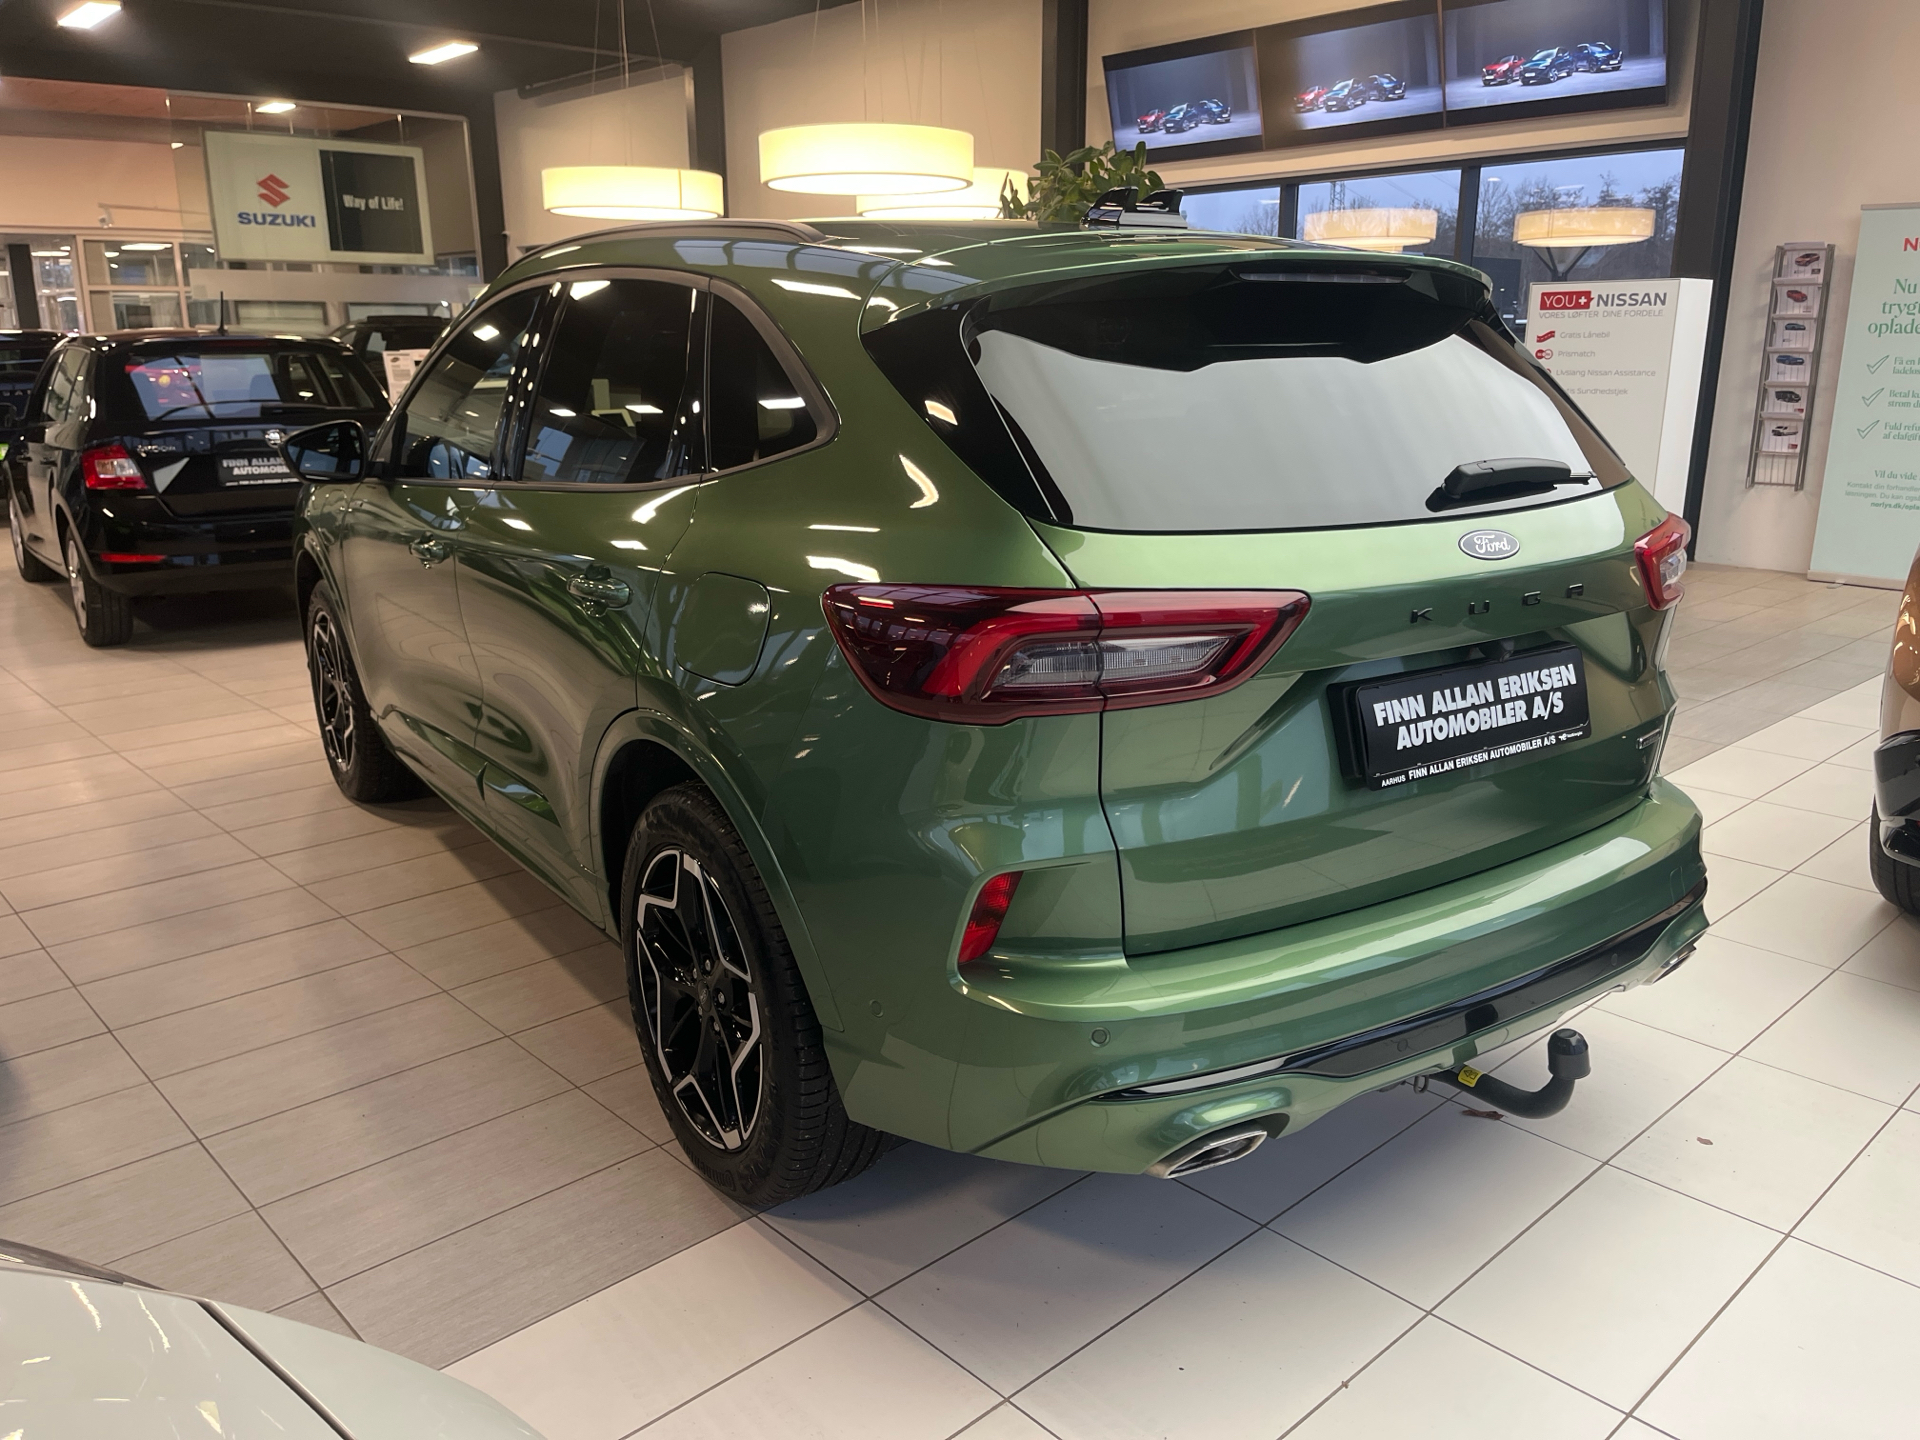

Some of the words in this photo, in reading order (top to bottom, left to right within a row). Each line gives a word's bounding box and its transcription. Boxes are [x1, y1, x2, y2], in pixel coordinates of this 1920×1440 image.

[343, 194, 366, 211] Way
[368, 195, 379, 209] of
[381, 196, 404, 211] Life!
[237, 212, 316, 228] SUZUKI
[1893, 278, 1918, 294] Nu
[1596, 292, 1668, 308] NISSAN
[1539, 311, 1566, 319] VORES
[1567, 310, 1600, 319] LØFTER
[1602, 310, 1622, 318] DINE
[1624, 309, 1663, 318] FORDELE
[1560, 331, 1582, 339] Gratis
[1557, 350, 1596, 358] Prismatch
[1613, 369, 1656, 377] Assistance
[1473, 534, 1511, 553] Ford
[1409, 583, 1584, 624] KUGA
[1373, 694, 1426, 727] FINN
[1432, 680, 1495, 715] ALLAN
[1498, 663, 1577, 700] ERIKSEN
[1396, 699, 1528, 751] AUTOMOBILER
[1532, 691, 1564, 721] A/S
[1381, 774, 1406, 787] AARHUS
[1408, 765, 1428, 780] FINN
[1429, 760, 1455, 776] ALLAN
[1455, 751, 1489, 770] ERIKSEN
[1490, 740, 1543, 760] AUTOMOBILER
[1543, 735, 1557, 747] A/S
